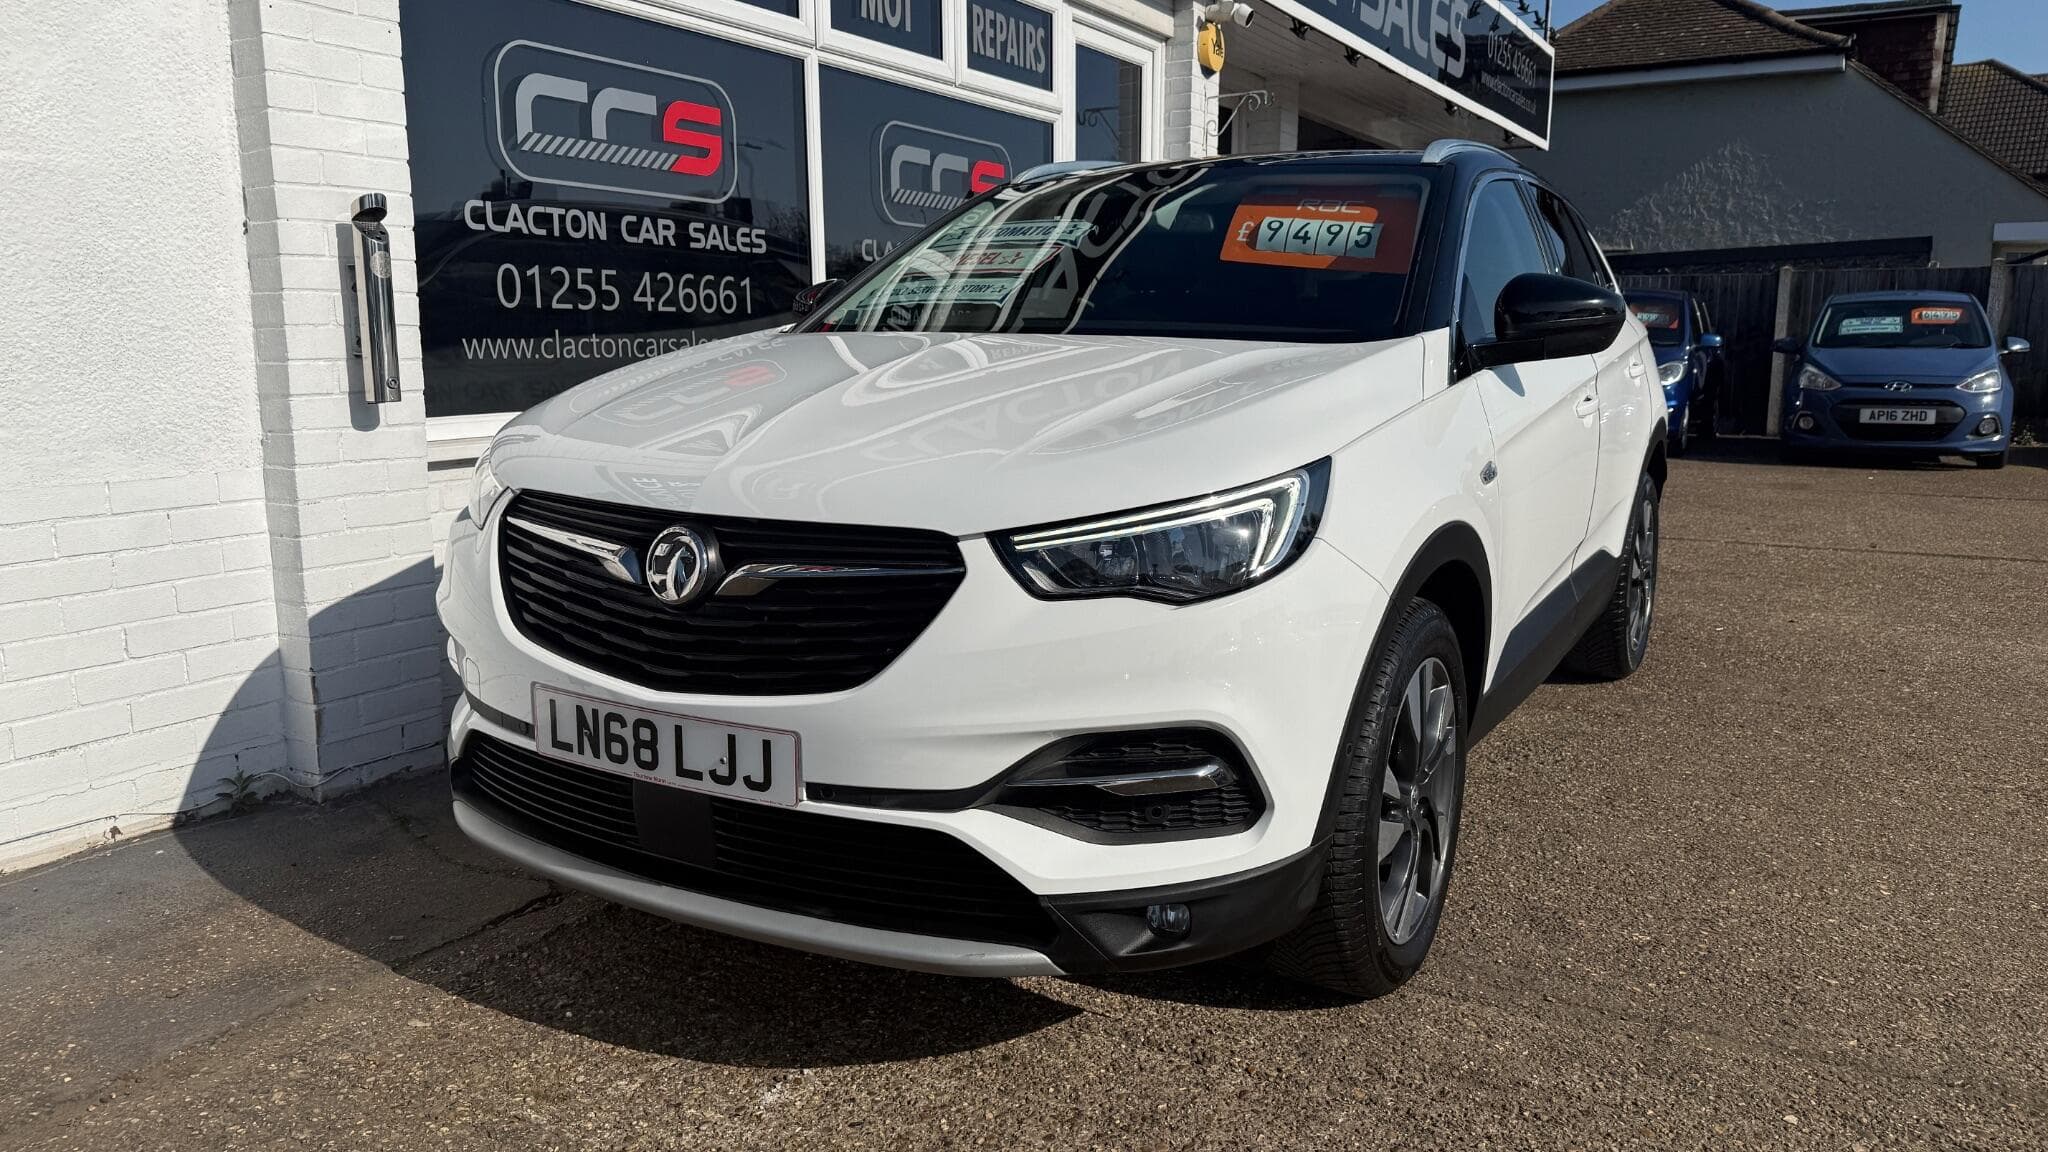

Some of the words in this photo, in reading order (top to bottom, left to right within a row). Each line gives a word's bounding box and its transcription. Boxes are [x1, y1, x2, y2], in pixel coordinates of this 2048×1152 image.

[972, 4, 1046, 74] REPAIRS
[1487, 30, 1512, 70] 01255
[1512, 48, 1537, 88] 426661
[516, 73, 722, 177] CCS
[463, 199, 607, 240] CLACTON
[620, 215, 676, 247] CAR
[688, 222, 767, 254] SALES
[1296, 199, 1364, 214] RAC
[496, 262, 620, 310] 01255
[633, 270, 752, 314] 426661
[1868, 410, 1898, 422] AP16
[1901, 410, 1928, 422] ZHD
[549, 698, 659, 771] LN68
[674, 723, 772, 792] LJJ
